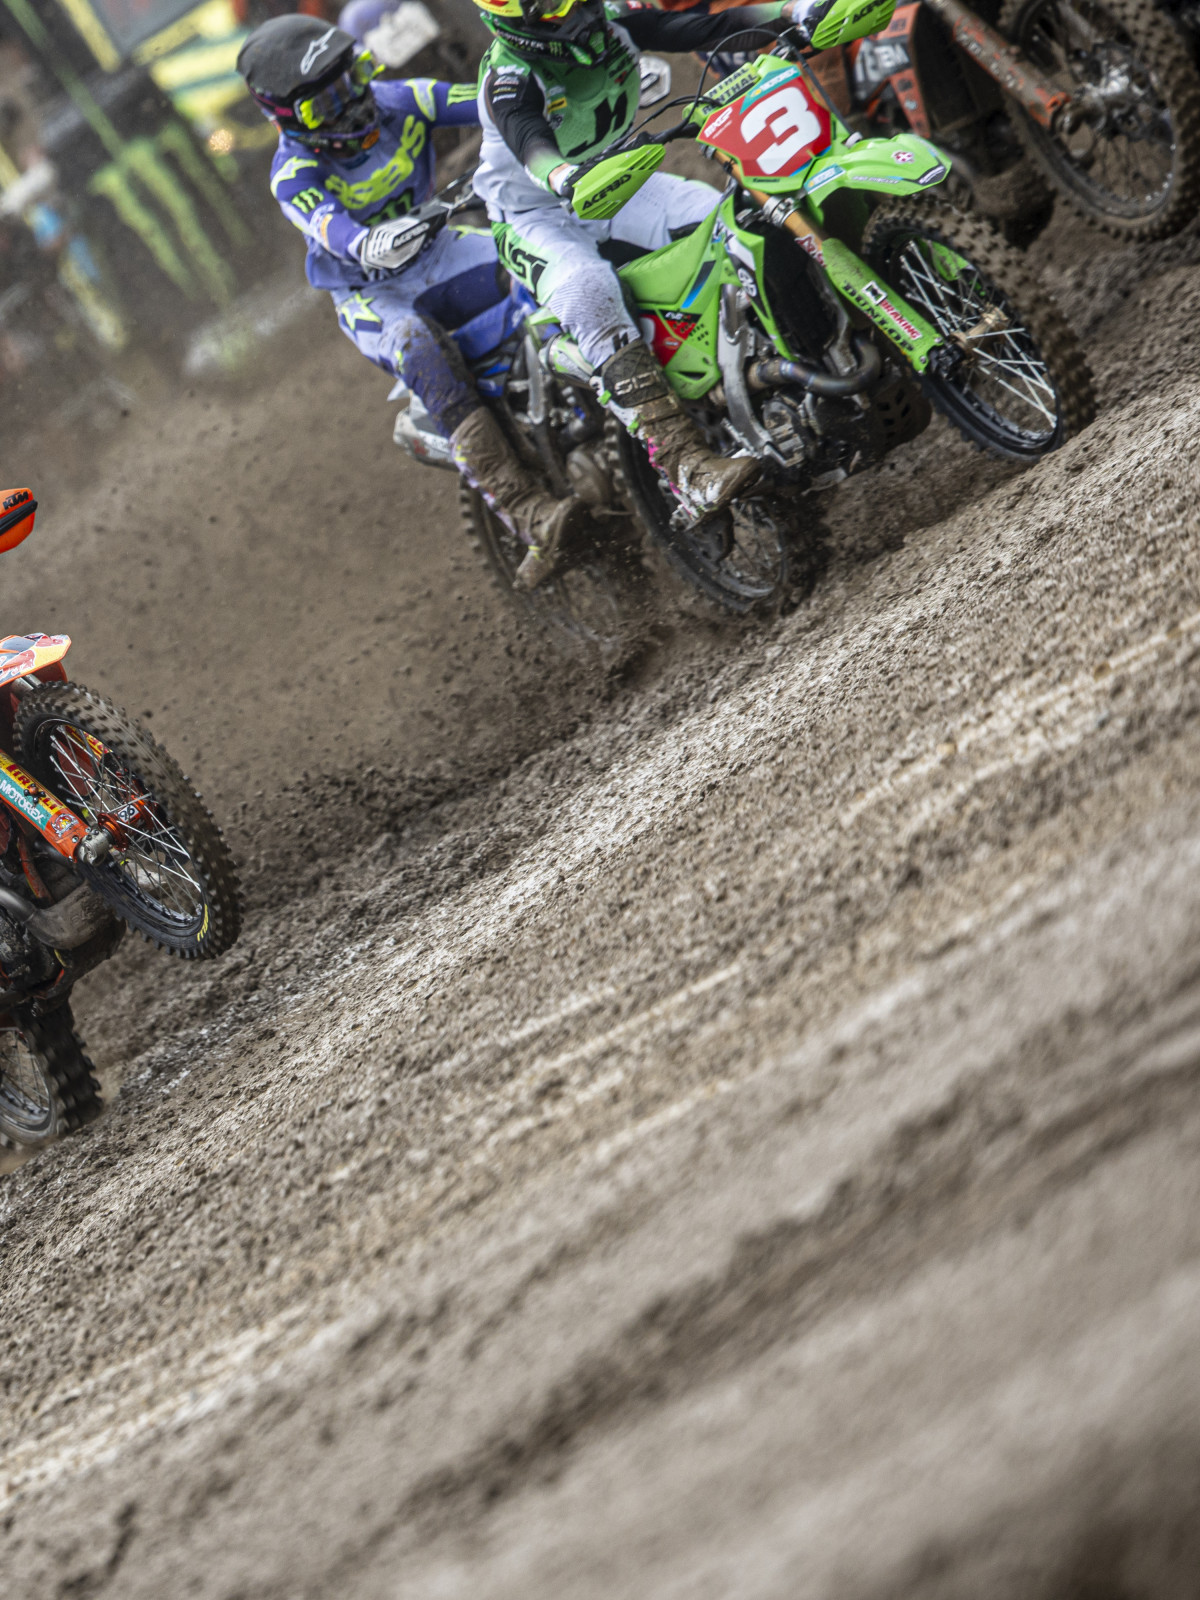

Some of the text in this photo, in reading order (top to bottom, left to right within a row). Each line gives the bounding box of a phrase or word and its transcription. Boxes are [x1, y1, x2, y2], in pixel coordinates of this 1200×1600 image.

[740, 86, 822, 176] 3
[842, 281, 914, 351] DUNLOP
[3, 491, 29, 511] KTM
[0, 779, 46, 825] MOTOREX
[6, 763, 58, 811] PIRLI
